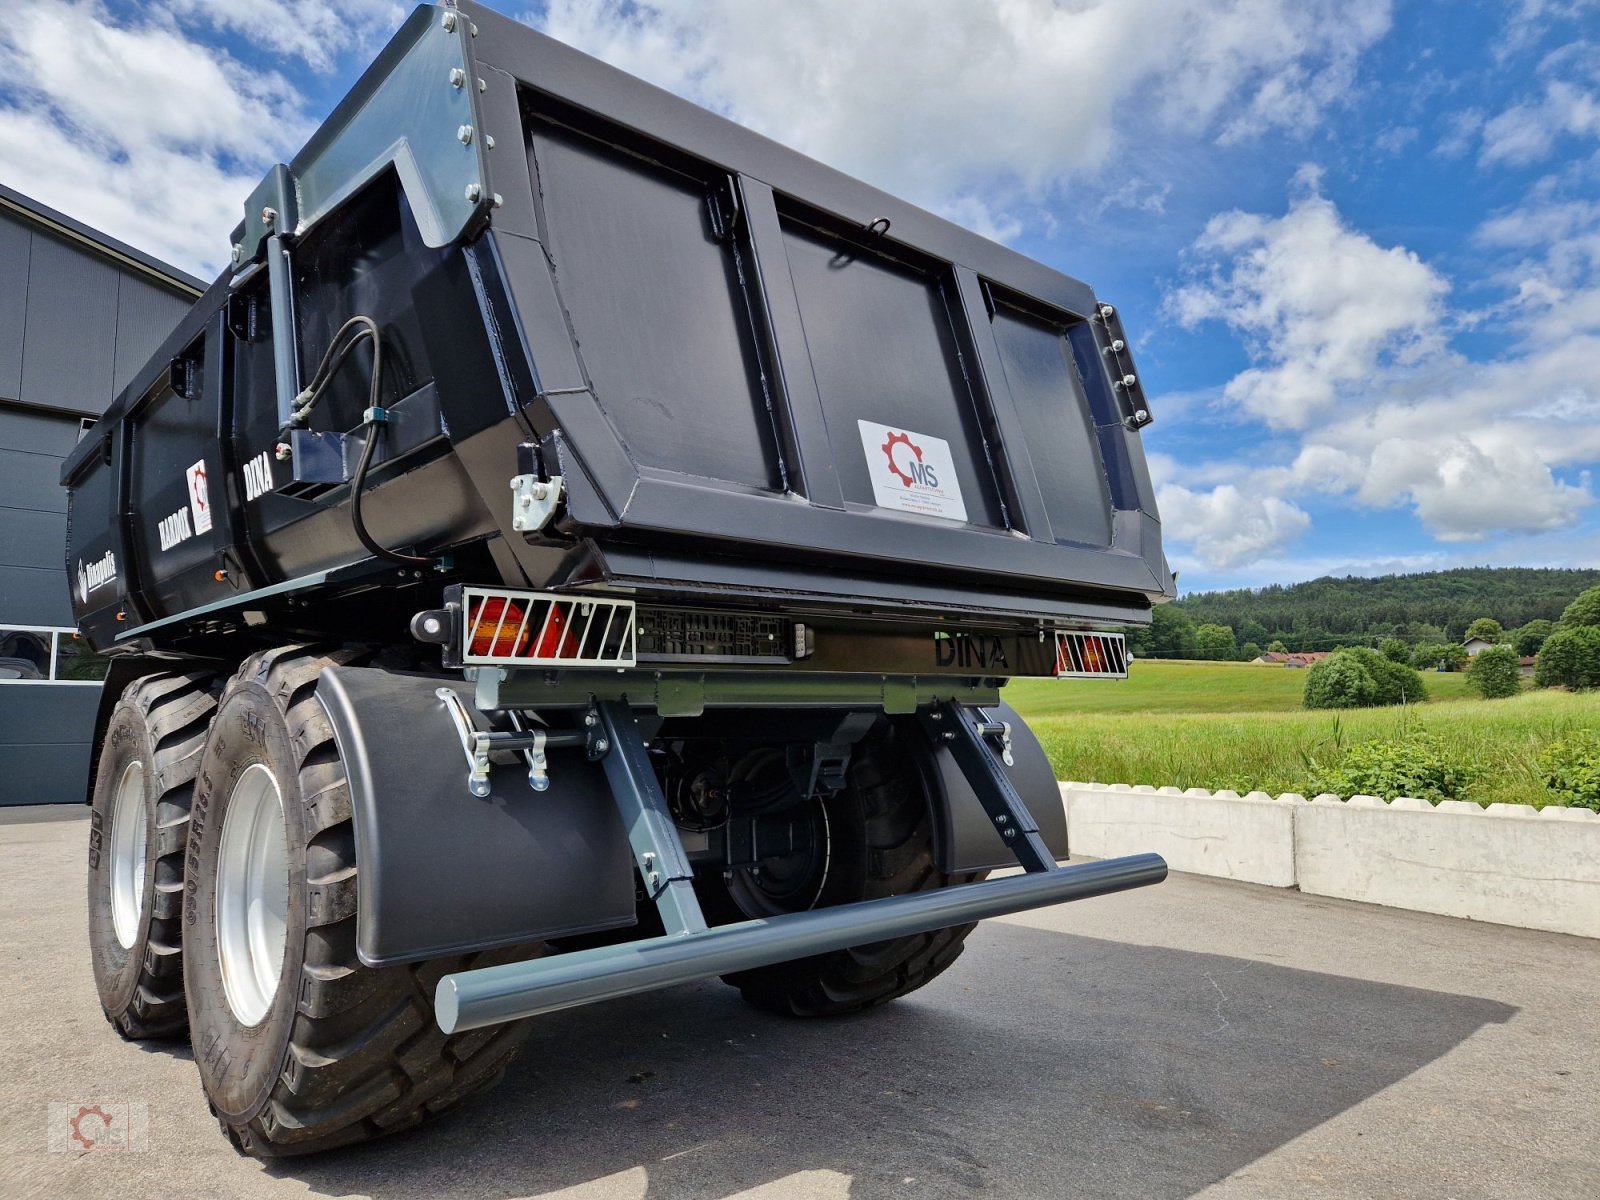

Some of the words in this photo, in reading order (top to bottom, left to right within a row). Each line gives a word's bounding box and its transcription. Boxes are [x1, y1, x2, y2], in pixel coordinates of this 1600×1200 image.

[243, 451, 274, 502] DINA
[909, 461, 939, 488] MS
[158, 505, 192, 552] HARDOX
[86, 550, 117, 589] Dinapolis
[933, 631, 1009, 669] DINA
